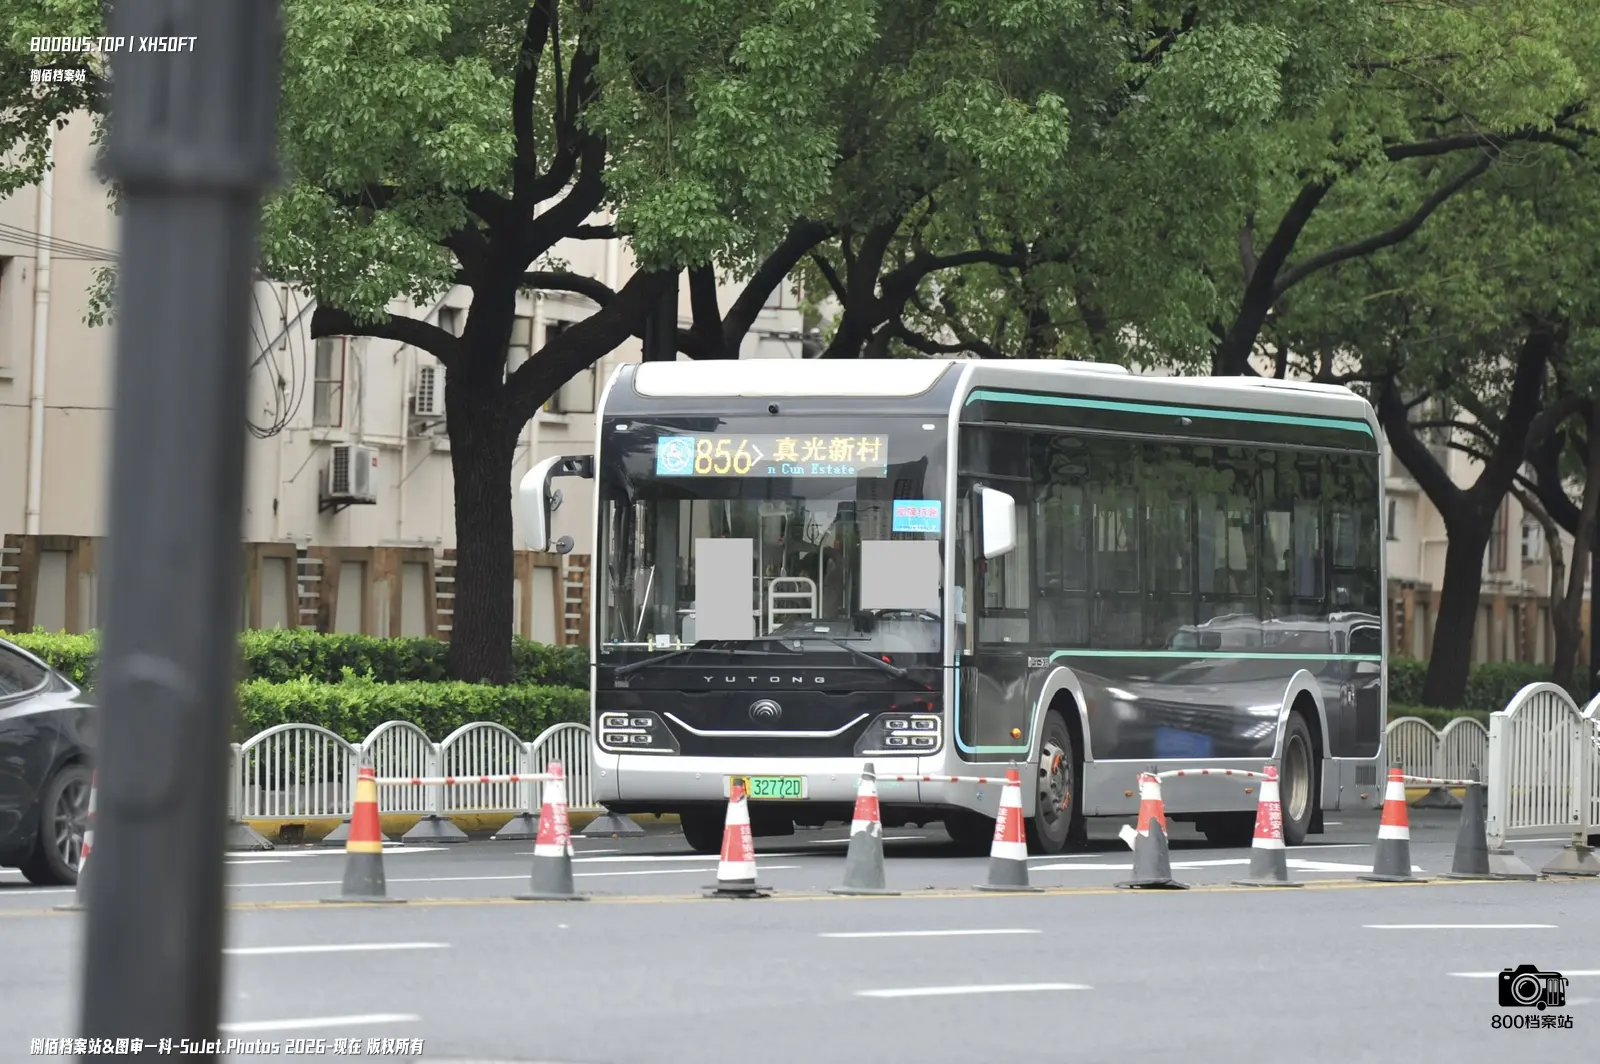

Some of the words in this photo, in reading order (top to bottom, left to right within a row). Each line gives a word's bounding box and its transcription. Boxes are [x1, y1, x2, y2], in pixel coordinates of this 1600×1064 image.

[694, 438, 752, 474] 856
[773, 436, 882, 462] 真光新村
[781, 463, 805, 474] Cun
[811, 463, 855, 474] Estate
[703, 676, 825, 684] YUTONG
